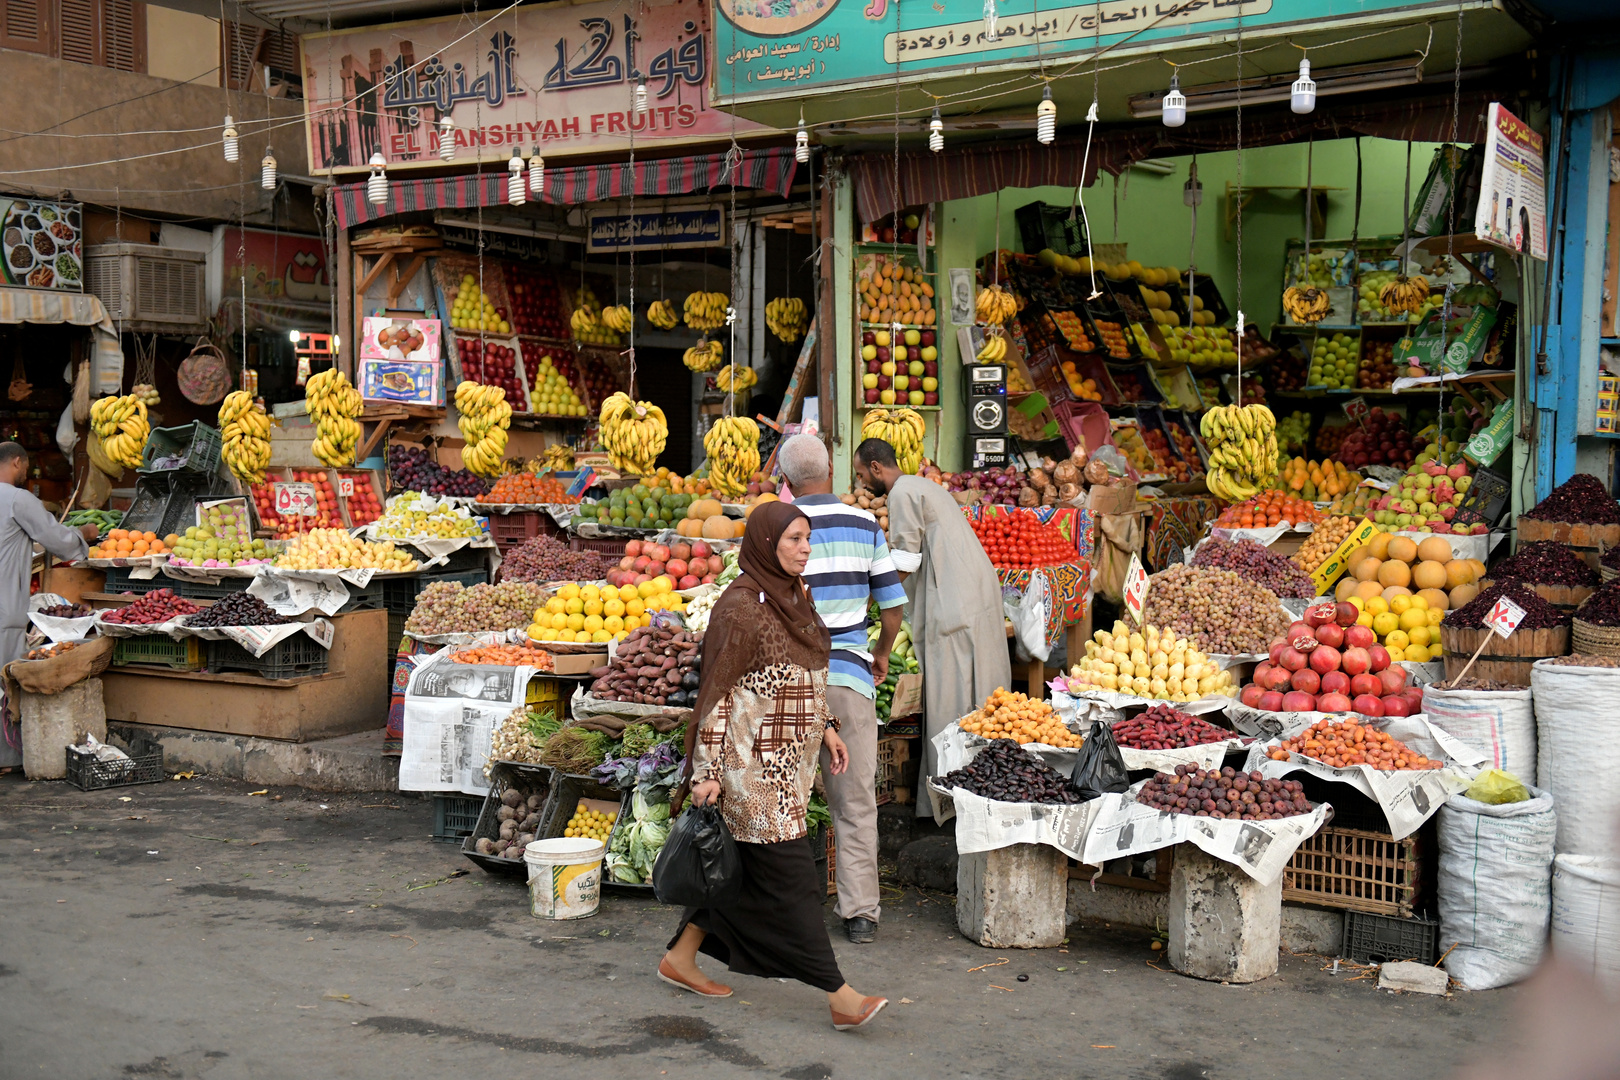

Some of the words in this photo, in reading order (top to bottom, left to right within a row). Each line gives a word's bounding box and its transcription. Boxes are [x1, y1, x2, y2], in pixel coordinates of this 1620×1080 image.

[384, 30, 526, 127] المنشية
[544, 13, 705, 98] فواكه
[770, 42, 801, 59] سعيد
[391, 134, 421, 154] EL
[429, 117, 580, 152] MANSHYAH
[590, 104, 697, 134] FRUITS
